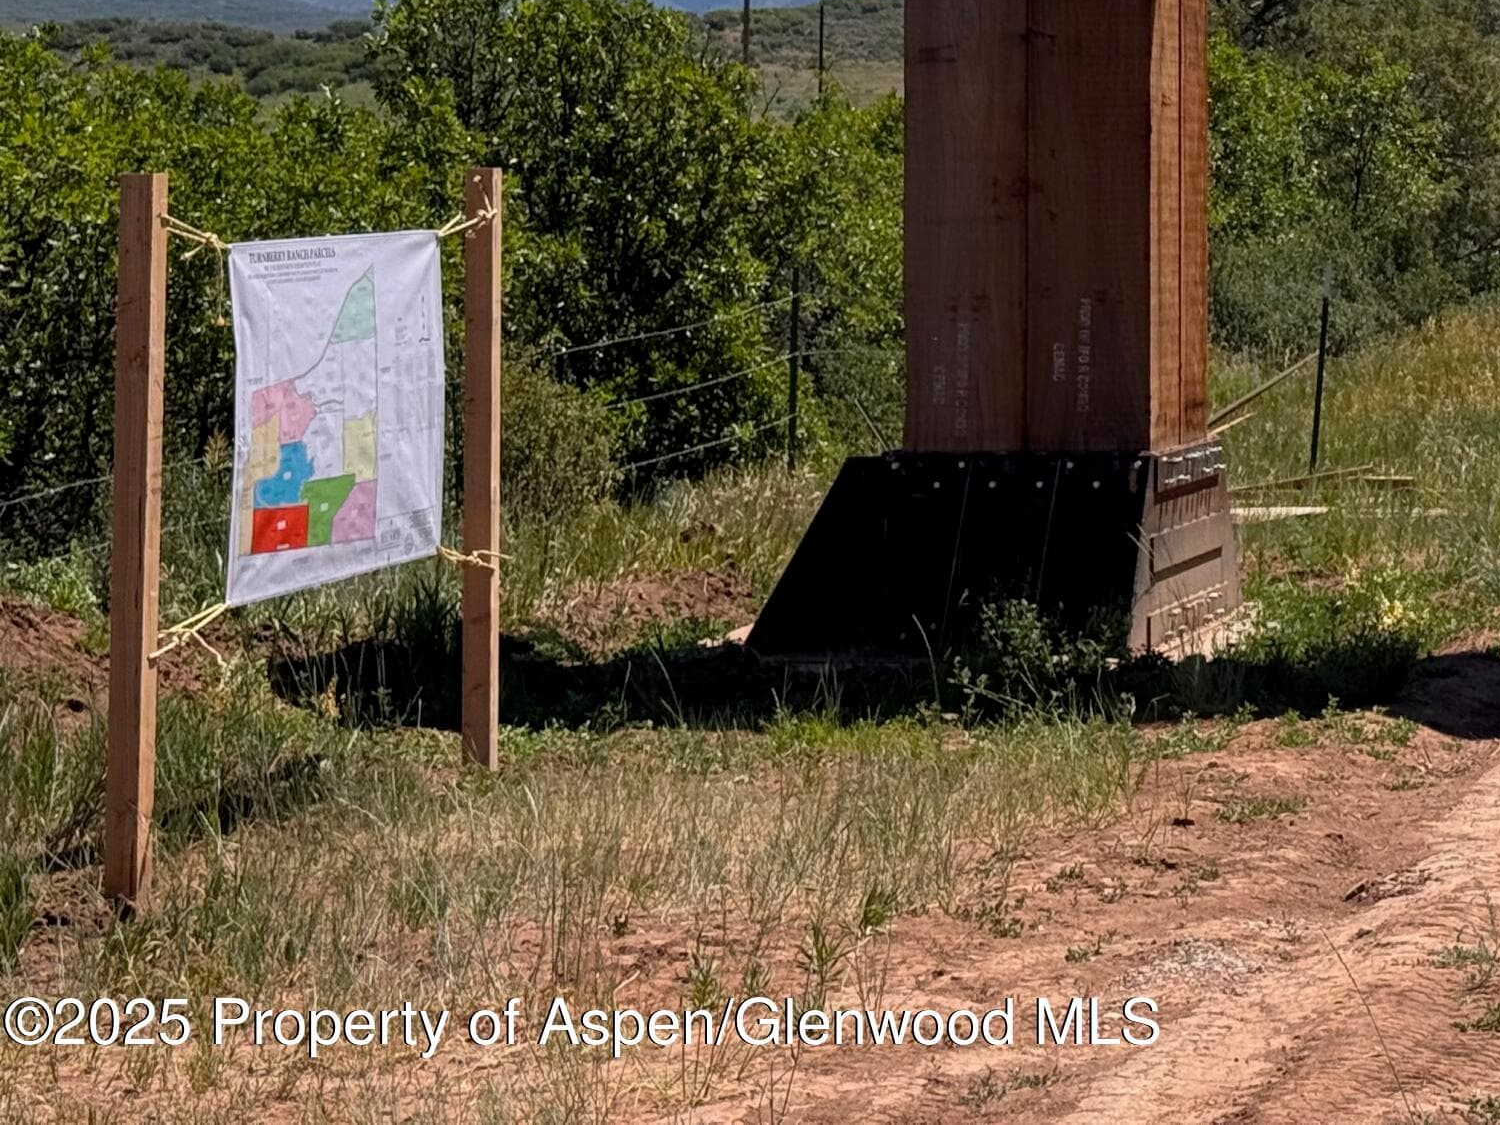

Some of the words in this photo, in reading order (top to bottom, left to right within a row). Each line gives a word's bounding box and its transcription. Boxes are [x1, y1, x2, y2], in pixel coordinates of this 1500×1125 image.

[248, 250, 286, 264] TURNBERRY
[286, 248, 310, 261] RANCH
[310, 246, 336, 260] PARCELS
